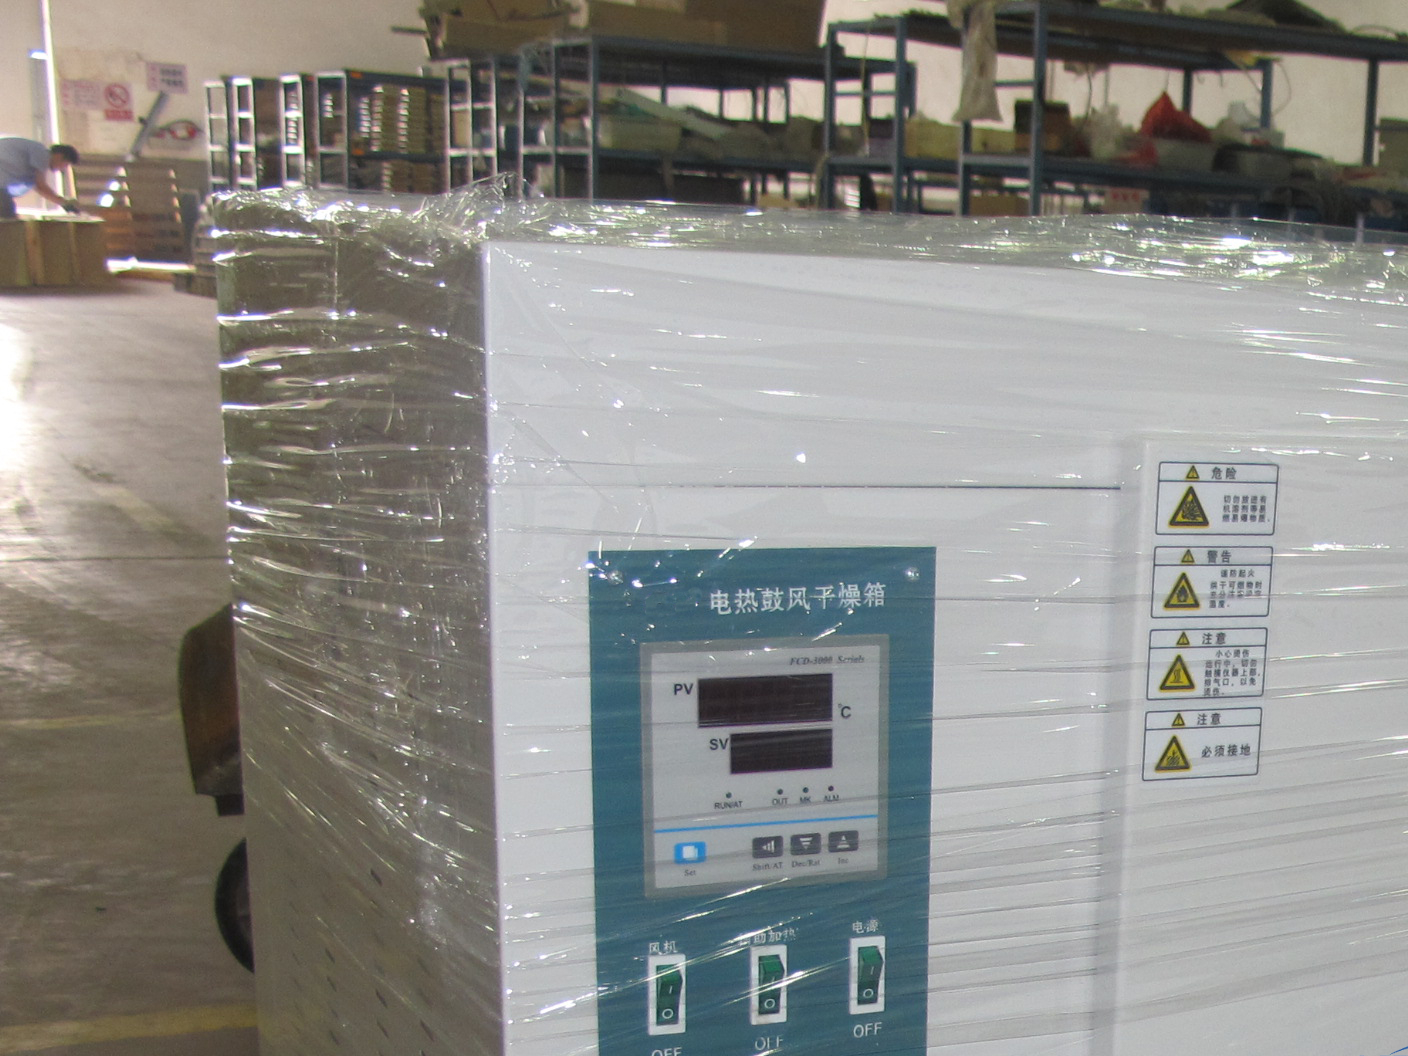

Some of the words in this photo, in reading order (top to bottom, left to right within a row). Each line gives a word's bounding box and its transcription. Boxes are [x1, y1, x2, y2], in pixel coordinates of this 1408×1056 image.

[1211, 467, 1237, 480] 危险
[1207, 550, 1232, 564] 警告
[710, 582, 887, 615] 电热鼓风干燥箱
[1202, 632, 1227, 645] 注意
[673, 682, 693, 696] PV
[1197, 713, 1222, 726] 注意
[709, 738, 729, 751] SV
[1201, 743, 1252, 759] 必须接地
[772, 797, 789, 806] OUT
[823, 794, 840, 803] ALM
[684, 869, 697, 877] Set
[852, 919, 879, 934] 电源
[649, 940, 677, 955] 风机
[853, 1022, 882, 1038] OFF
